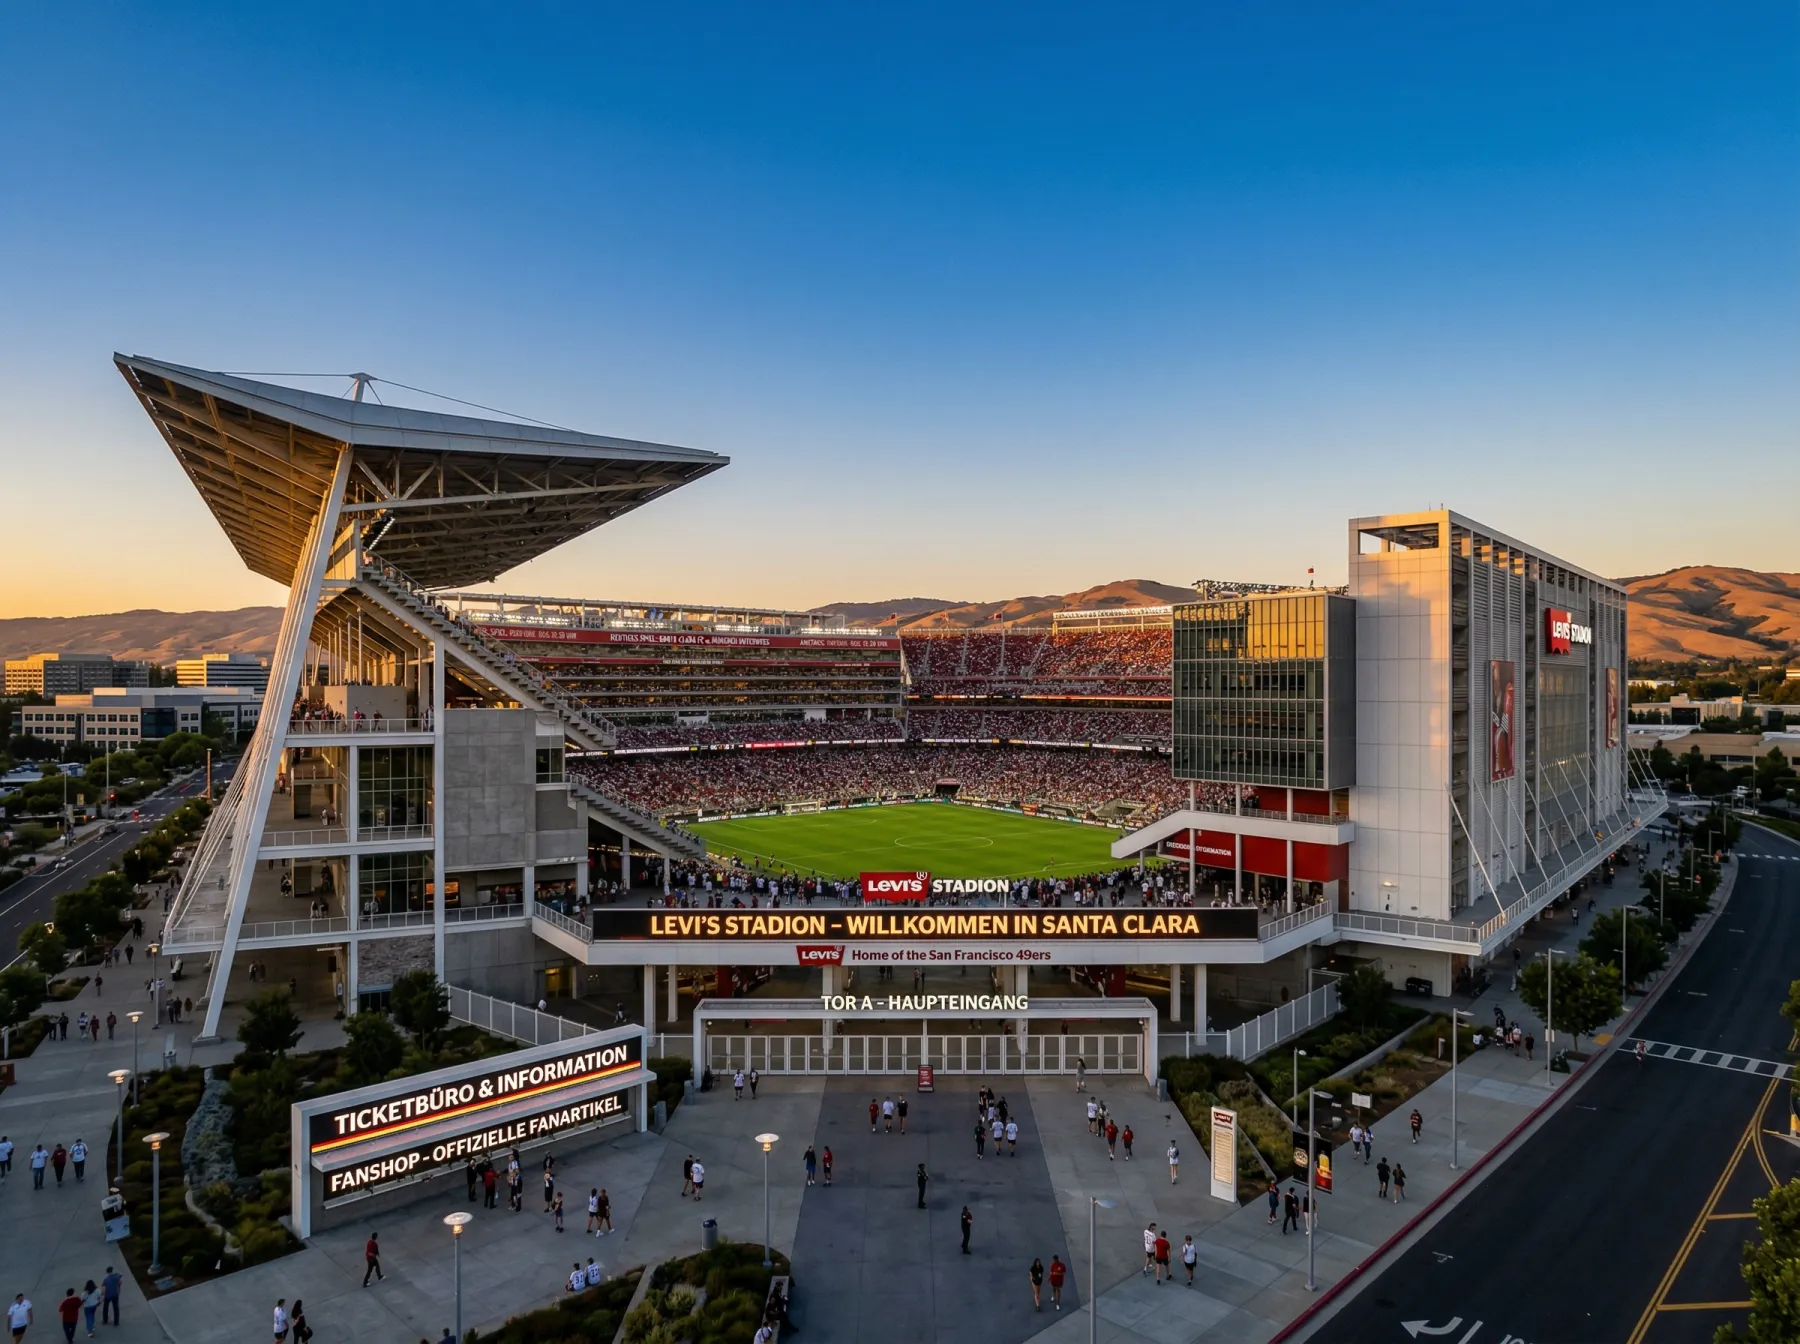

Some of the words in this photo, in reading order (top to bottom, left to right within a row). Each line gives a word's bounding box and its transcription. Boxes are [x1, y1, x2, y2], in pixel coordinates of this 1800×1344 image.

[932, 879, 1010, 893] STADION
[650, 915, 720, 936] LEVI'S
[725, 915, 825, 936] STADION
[846, 915, 1008, 935] WILLKOMMEN
[1014, 915, 1037, 935] IN
[1042, 915, 1118, 935] SANTA
[1122, 915, 1200, 935] CLARA
[852, 949, 889, 961] Home
[891, 949, 905, 961] of
[906, 950, 927, 961] the
[929, 949, 952, 961] San
[954, 949, 1014, 961] Francisco
[1015, 949, 1051, 961] 49ers
[821, 995, 857, 1010] TOR
[860, 995, 873, 1010] A
[888, 995, 1029, 1010] HAUPTEINGANG
[334, 1084, 474, 1135] TICKETBÜRO
[478, 1079, 494, 1098] &
[497, 1045, 627, 1094] INFORMATION
[331, 1152, 420, 1192] FANSHOP
[432, 1122, 526, 1162] OFFIZIELLE
[529, 1096, 622, 1135] FANARTIKEL
